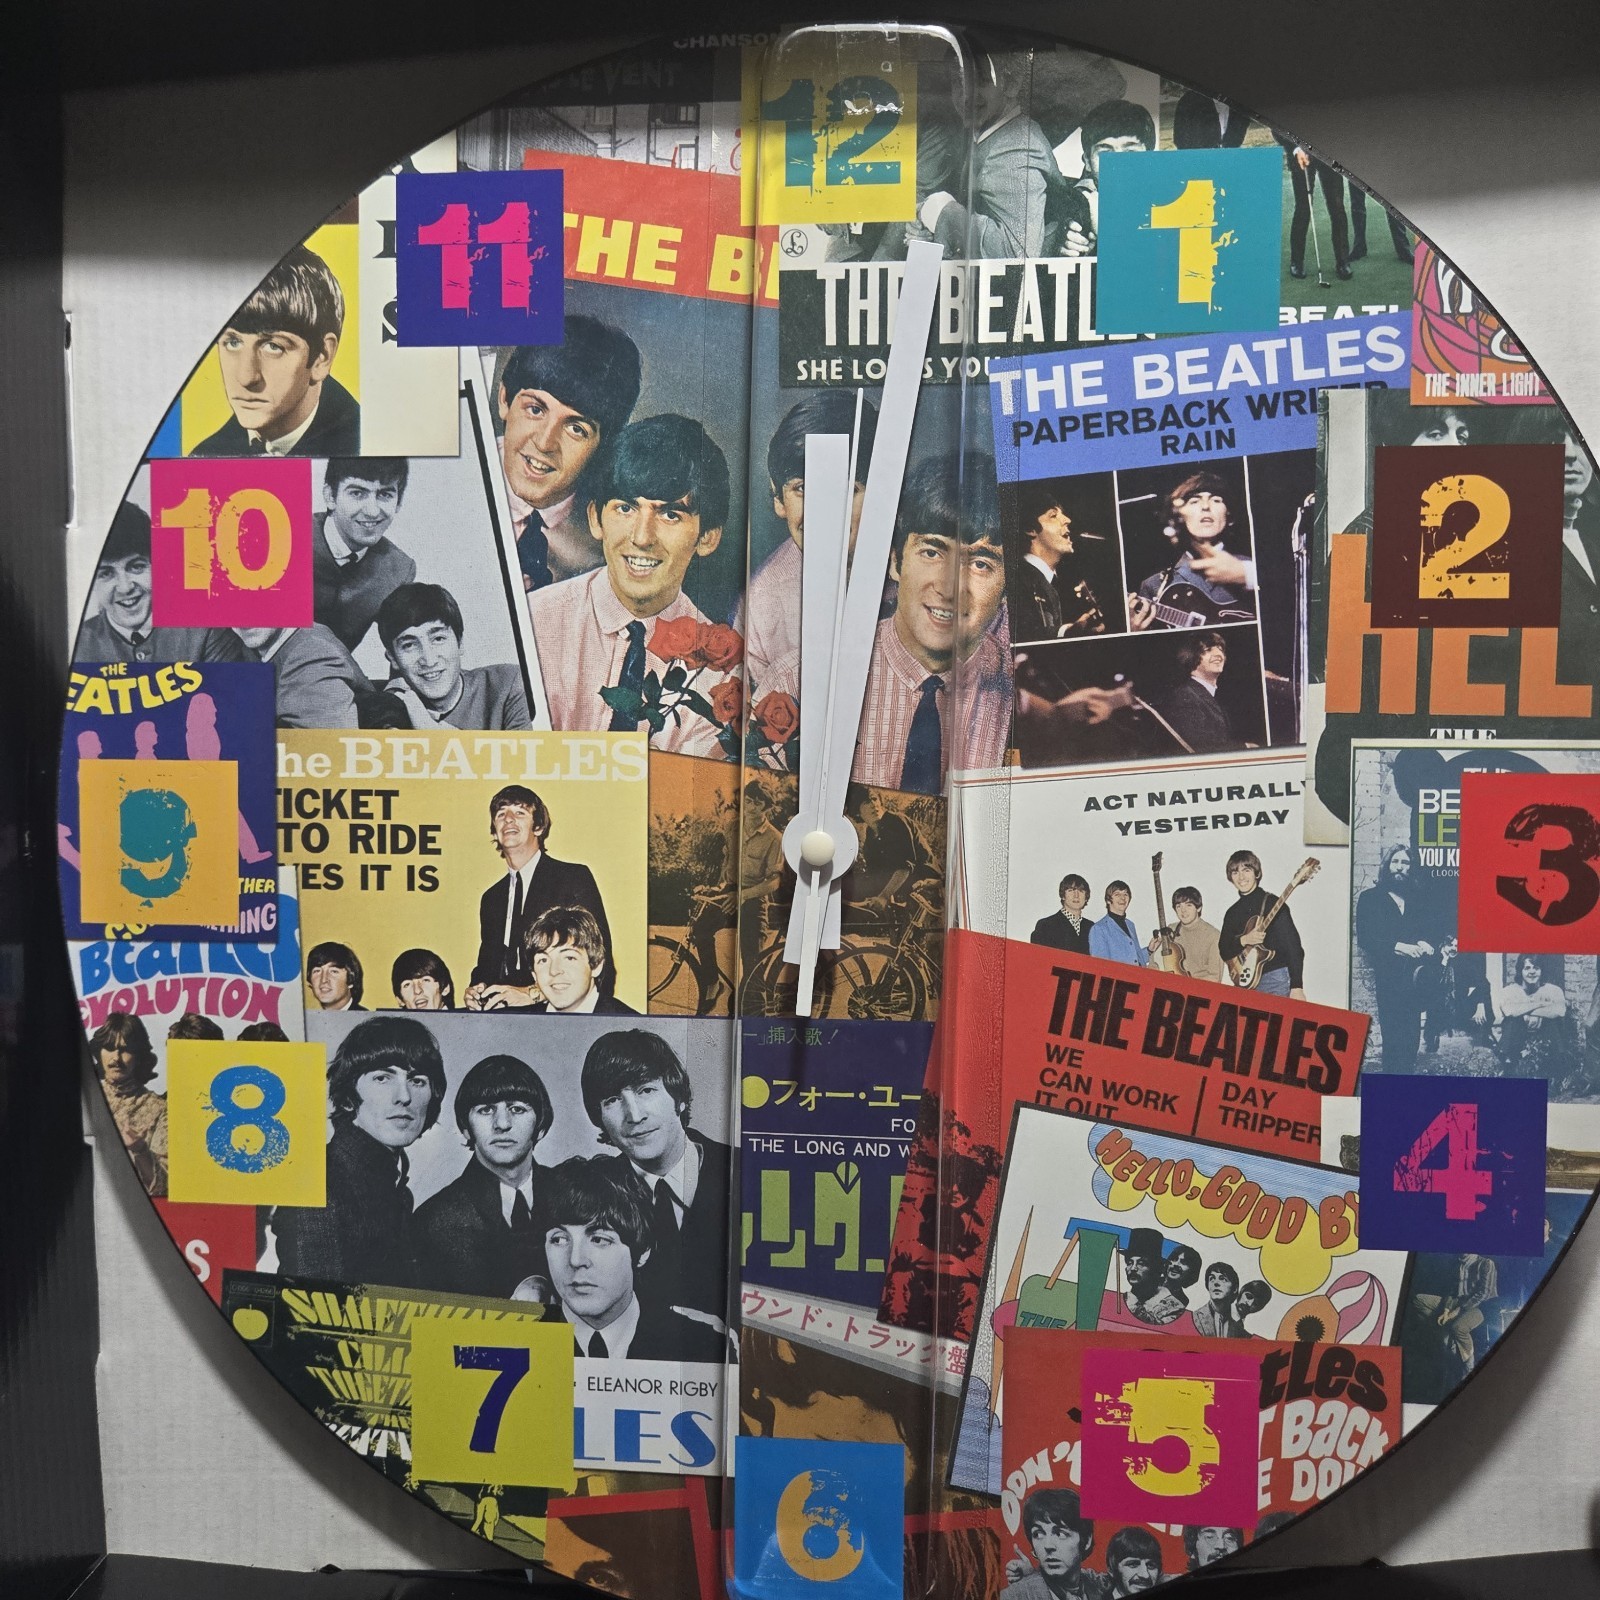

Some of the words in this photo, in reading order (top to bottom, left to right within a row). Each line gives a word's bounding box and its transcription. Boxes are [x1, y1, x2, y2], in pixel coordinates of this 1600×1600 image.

[761, 76, 901, 188] 12
[416, 202, 536, 315] 11
[1148, 179, 1221, 310] 1
[939, 258, 1157, 344] BEATL
[797, 359, 843, 381] SHE
[853, 358, 935, 380] LOS
[989, 360, 1107, 416] THE
[1133, 326, 1406, 400] BEATLES
[1424, 373, 1450, 397] THE
[1455, 373, 1496, 397] INNER
[1502, 372, 1541, 396] LIGHT
[1012, 397, 1231, 448] PAPERBACK
[1244, 380, 1388, 421] WRI
[1161, 428, 1236, 456] RAIN
[159, 489, 293, 590] 10
[1419, 474, 1511, 599] 2
[100, 662, 128, 677] THE
[277, 739, 332, 778] he
[339, 736, 648, 782] BEATLES
[1084, 794, 1137, 812] ACT
[1147, 781, 1307, 807] NATURALL
[1115, 809, 1289, 836] YESTERDAY
[119, 787, 197, 899] 9
[277, 822, 330, 853] TO
[349, 824, 442, 855] RIDE
[1418, 848, 1443, 867] YOU
[1496, 803, 1600, 926] 3
[277, 862, 344, 892] ES
[360, 864, 392, 891] IT
[406, 865, 440, 893] IS
[1045, 1043, 1085, 1069] WE
[1047, 966, 1140, 1051] THE
[1141, 988, 1348, 1095] BEATLES
[205, 1065, 290, 1173] 8
[1039, 1067, 1093, 1095] CAN
[1102, 1079, 1181, 1115] WORK
[1222, 1081, 1278, 1110] DAY
[749, 1138, 785, 1153] THE
[794, 1139, 845, 1156] LONG
[853, 1141, 891, 1157] AND
[1393, 1103, 1493, 1220] 4
[1199, 1165, 1308, 1244] GOOD
[453, 1345, 530, 1453] 7
[587, 1377, 663, 1394] ELEANOR
[669, 1380, 718, 1397] RIGBY
[1096, 1377, 1220, 1496] 5
[776, 1470, 864, 1581] 6
